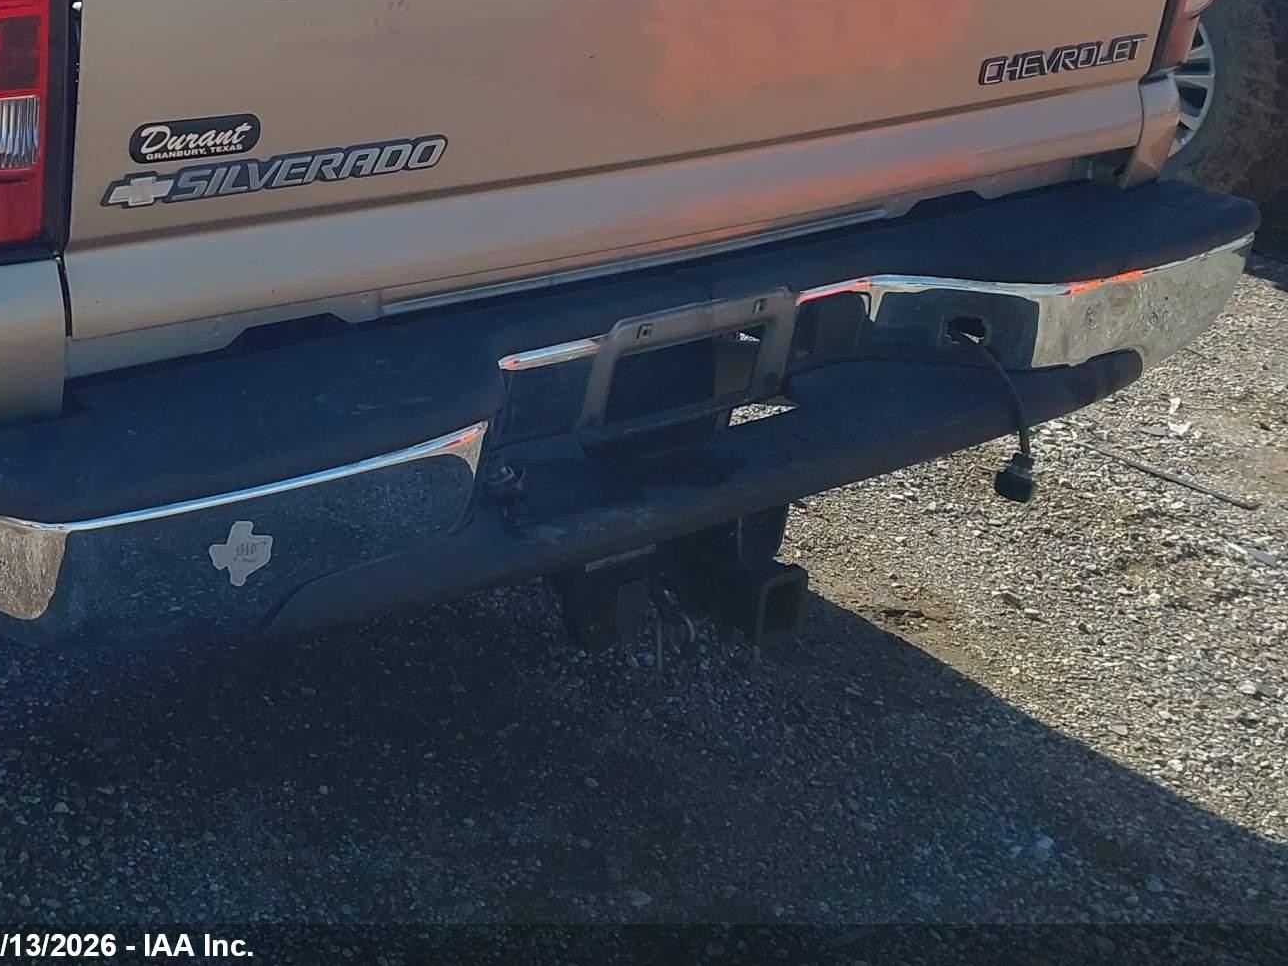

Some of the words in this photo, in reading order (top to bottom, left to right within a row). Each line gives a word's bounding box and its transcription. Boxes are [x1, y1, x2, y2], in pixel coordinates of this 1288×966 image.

[978, 34, 1148, 85] CHEVROLET
[140, 122, 252, 154] Durant
[146, 147, 207, 161] GRANBURY,
[209, 143, 243, 153] TEXAS
[168, 134, 448, 203] SILVERADO
